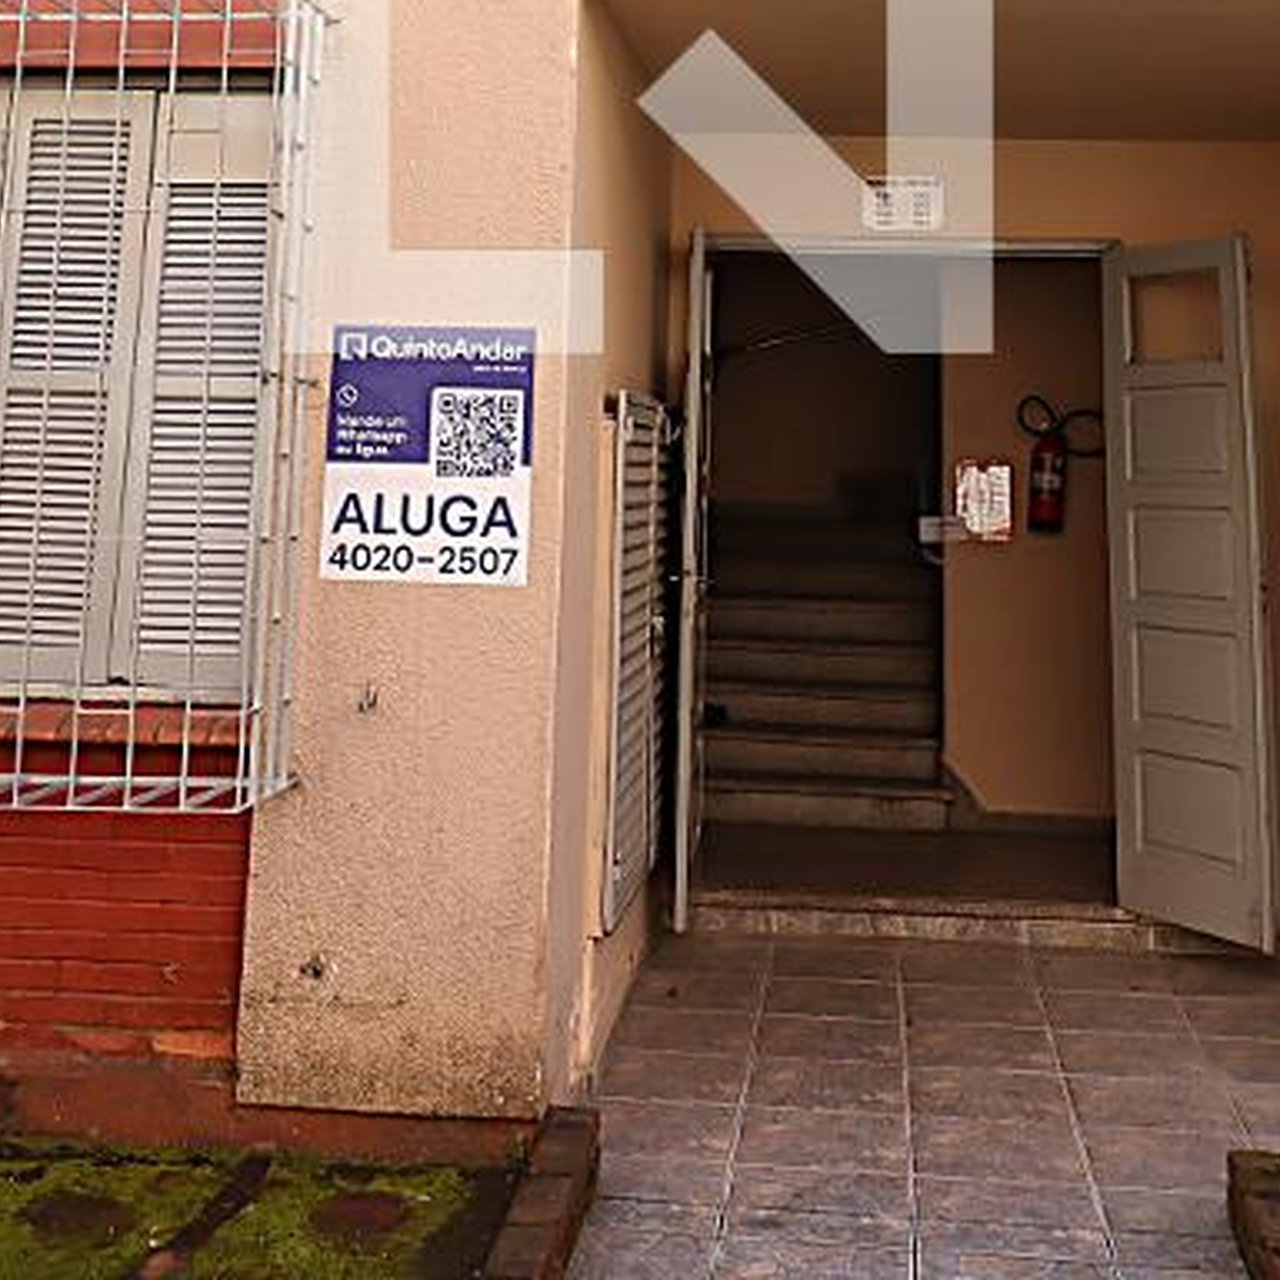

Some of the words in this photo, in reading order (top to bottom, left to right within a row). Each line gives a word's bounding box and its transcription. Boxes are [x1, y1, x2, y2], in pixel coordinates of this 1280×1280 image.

[371, 336, 527, 361] QuintoAndar
[332, 493, 518, 538] ALUGA
[329, 544, 519, 576] 4020-2507
